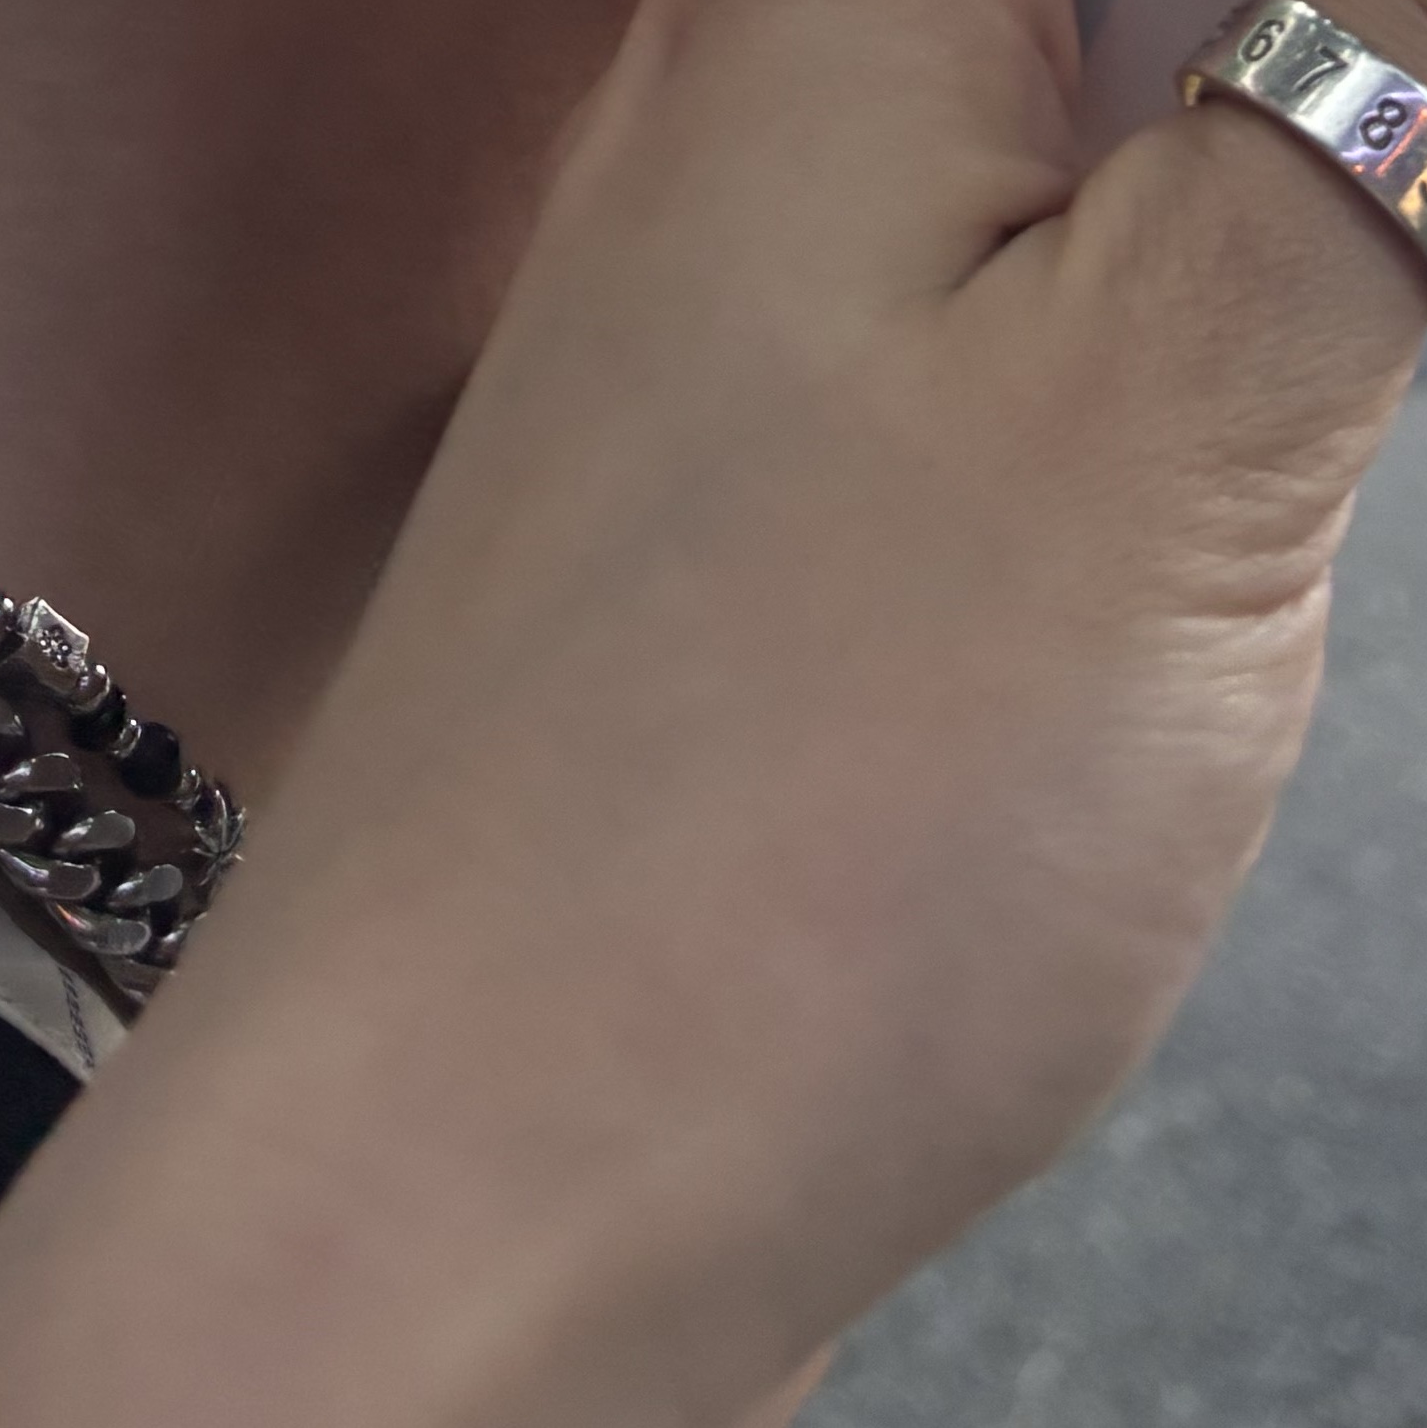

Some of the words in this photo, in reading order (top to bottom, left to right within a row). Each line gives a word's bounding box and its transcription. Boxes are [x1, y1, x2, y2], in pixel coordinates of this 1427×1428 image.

[1238, 17, 1287, 64] 6
[1297, 47, 1348, 93] 7
[1360, 98, 1408, 151] 8
